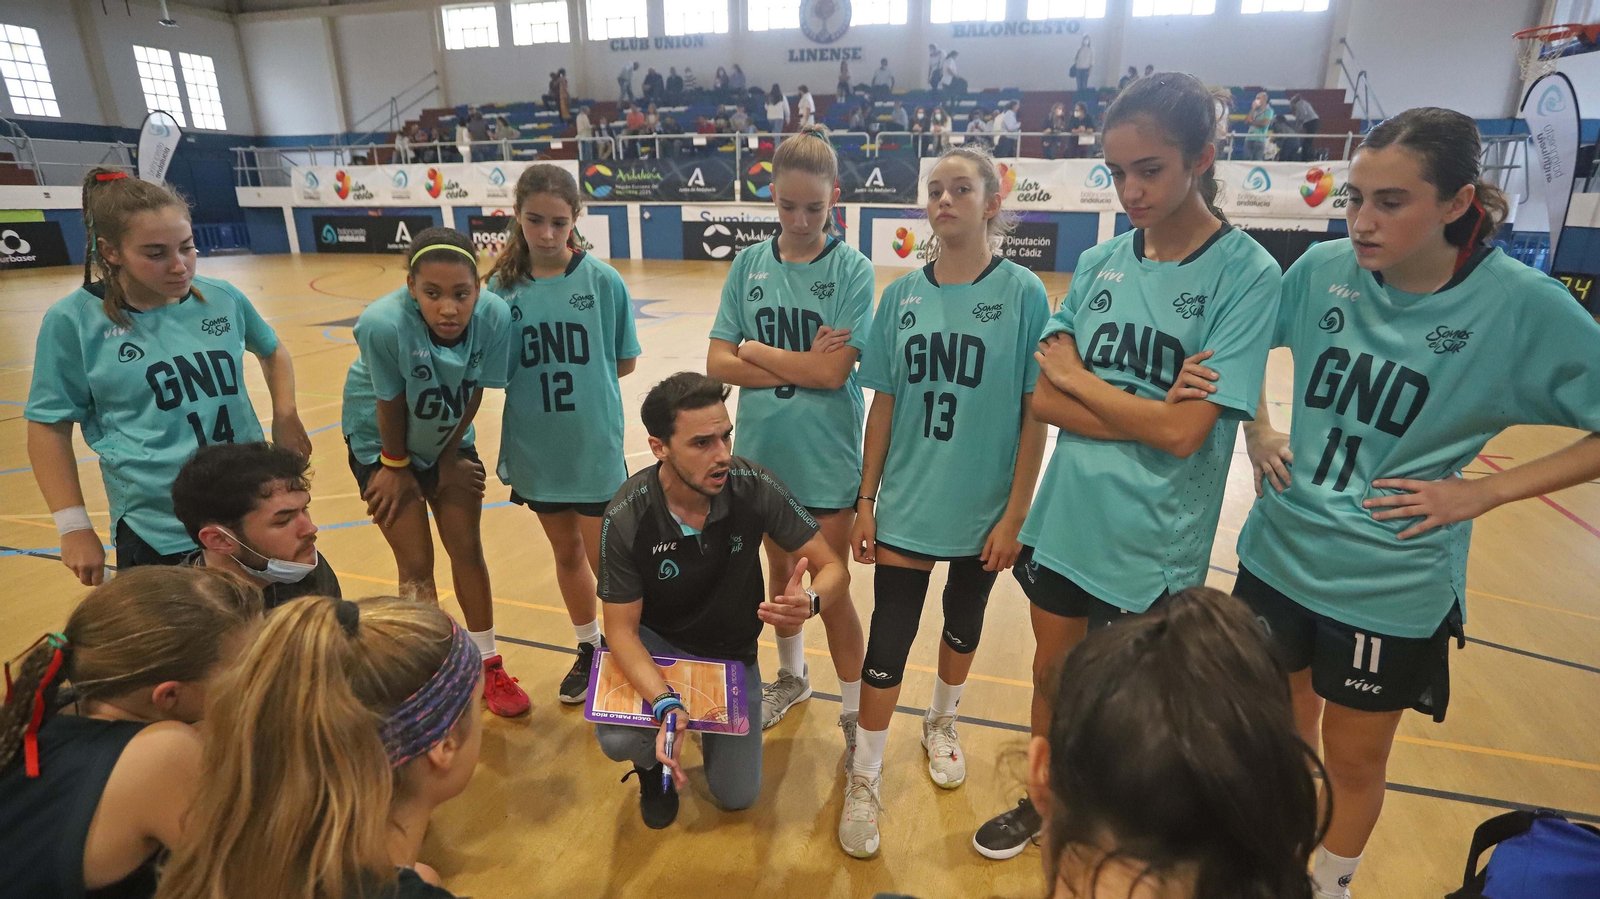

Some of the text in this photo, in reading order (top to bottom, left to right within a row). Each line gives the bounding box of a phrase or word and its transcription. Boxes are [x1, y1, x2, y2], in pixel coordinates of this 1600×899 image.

[610, 37, 649, 51] CLUB
[953, 20, 1080, 37] BALONCESTO
[788, 47, 862, 62] LINENSE
[1017, 189, 1052, 202] cesto
[1006, 236, 1051, 247] Diputación
[1006, 246, 1042, 258] de Cádiz
[103, 325, 132, 339] viv
[202, 316, 228, 332] Somos
[755, 306, 824, 352] GND
[520, 321, 590, 369] GND
[905, 332, 986, 389] GND
[1085, 322, 1186, 392] GND
[145, 350, 239, 412] GND
[540, 371, 576, 413] 12
[1305, 346, 1431, 438] GND
[186, 404, 235, 447] 14
[923, 391, 958, 442] 13
[1311, 427, 1363, 493] 11
[652, 541, 677, 555] vive
[1352, 632, 1382, 673] 11
[1344, 678, 1382, 694] vive
